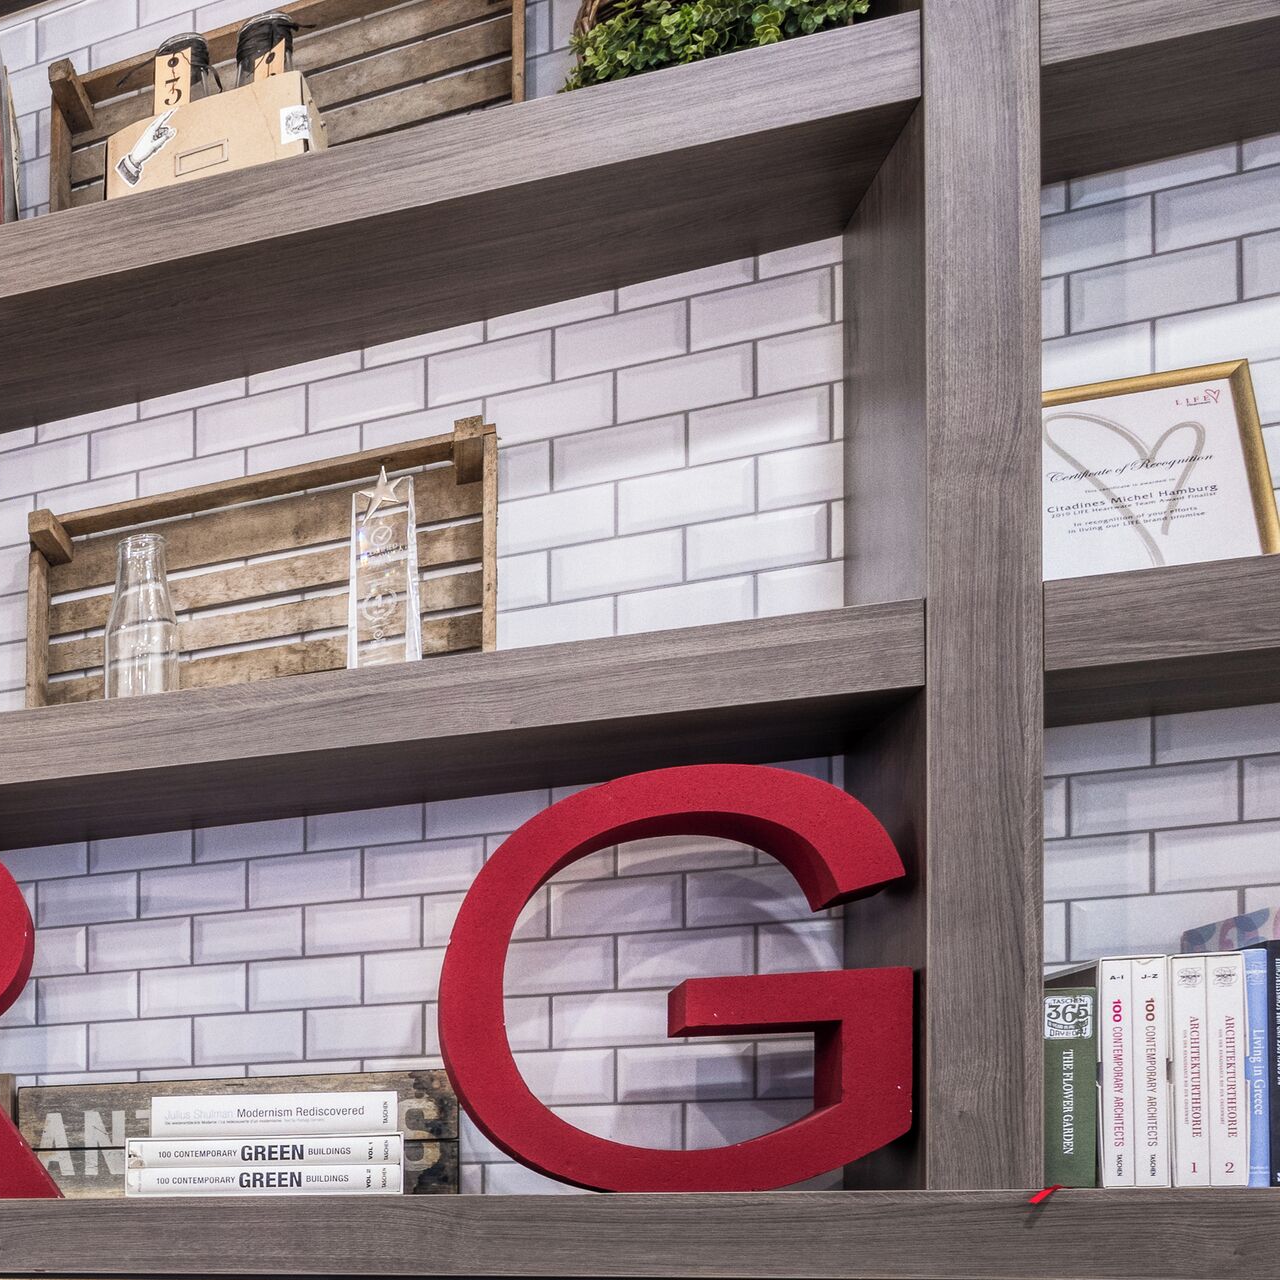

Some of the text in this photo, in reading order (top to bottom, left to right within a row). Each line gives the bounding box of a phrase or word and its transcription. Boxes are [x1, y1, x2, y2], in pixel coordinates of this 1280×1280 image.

[1046, 454, 1213, 482] Certificate of Recognition
[1047, 484, 1218, 514] Citadines Michel Hamburg
[1078, 525, 1104, 533] living
[1144, 516, 1168, 524] brand
[1170, 512, 1206, 520] promise
[1085, 515, 1133, 524] recognition
[1148, 510, 1167, 518] your
[1046, 1004, 1088, 1023] 365
[1112, 999, 1124, 1147] 100 CONTEMPORARY ARCHITECTS
[1145, 998, 1157, 1147] 100 CONTEMPORARY ARCHITECTS
[1189, 1016, 1202, 1138] ARCHITEKTURTHEORIE
[1225, 1016, 1238, 1138] ARCHITEKTURTHEORIE
[1248, 1029, 1265, 1115] Living in Greece
[165, 1106, 364, 1120] Julius Shulman Modernism Rediscovered
[1062, 1049, 1074, 1155] THE FLOWER GARDEN
[174, 1150, 238, 1158] CONTEMPORARY
[241, 1144, 304, 1161] GREEN
[308, 1147, 352, 1156] BUILDINGS
[172, 1176, 235, 1184] CONTEMPORARY
[239, 1172, 302, 1188] GREEN
[306, 1174, 350, 1183] BUILDINGS
[1190, 1162, 1198, 1174] 1
[1225, 1162, 1234, 1174] 2
